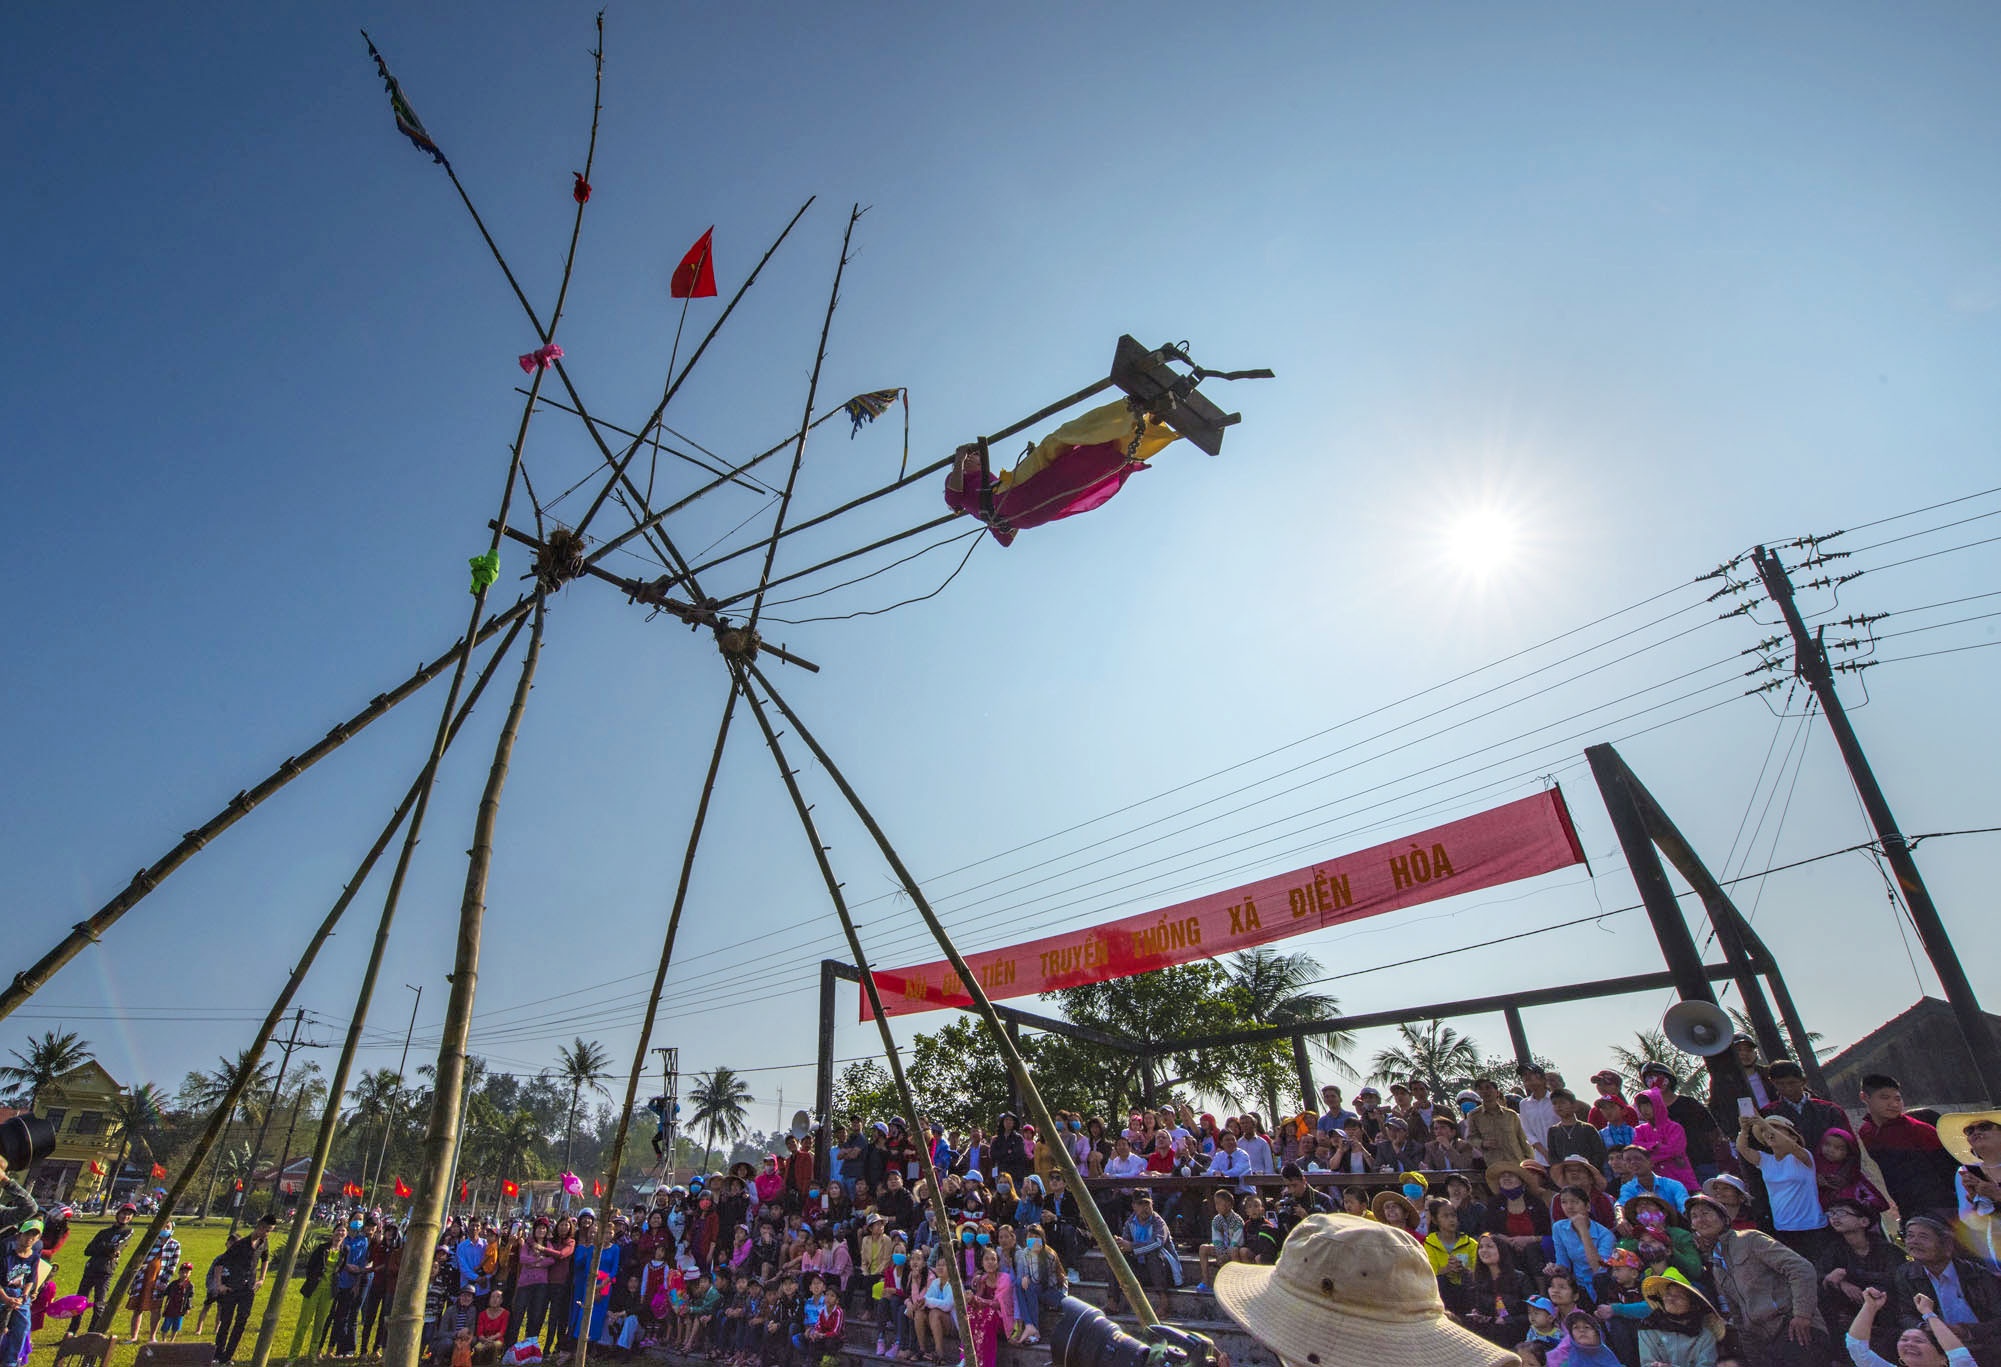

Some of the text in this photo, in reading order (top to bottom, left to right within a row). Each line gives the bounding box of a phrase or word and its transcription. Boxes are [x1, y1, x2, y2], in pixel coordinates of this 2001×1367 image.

[981, 957, 1016, 989] TIÊN
[1039, 933, 1109, 978] TRUYỀN
[1131, 913, 1202, 959] THỐNG
[1227, 895, 1262, 936] XÃ
[1288, 869, 1353, 919] ĐIỀN
[1389, 843, 1455, 890] HÒA
